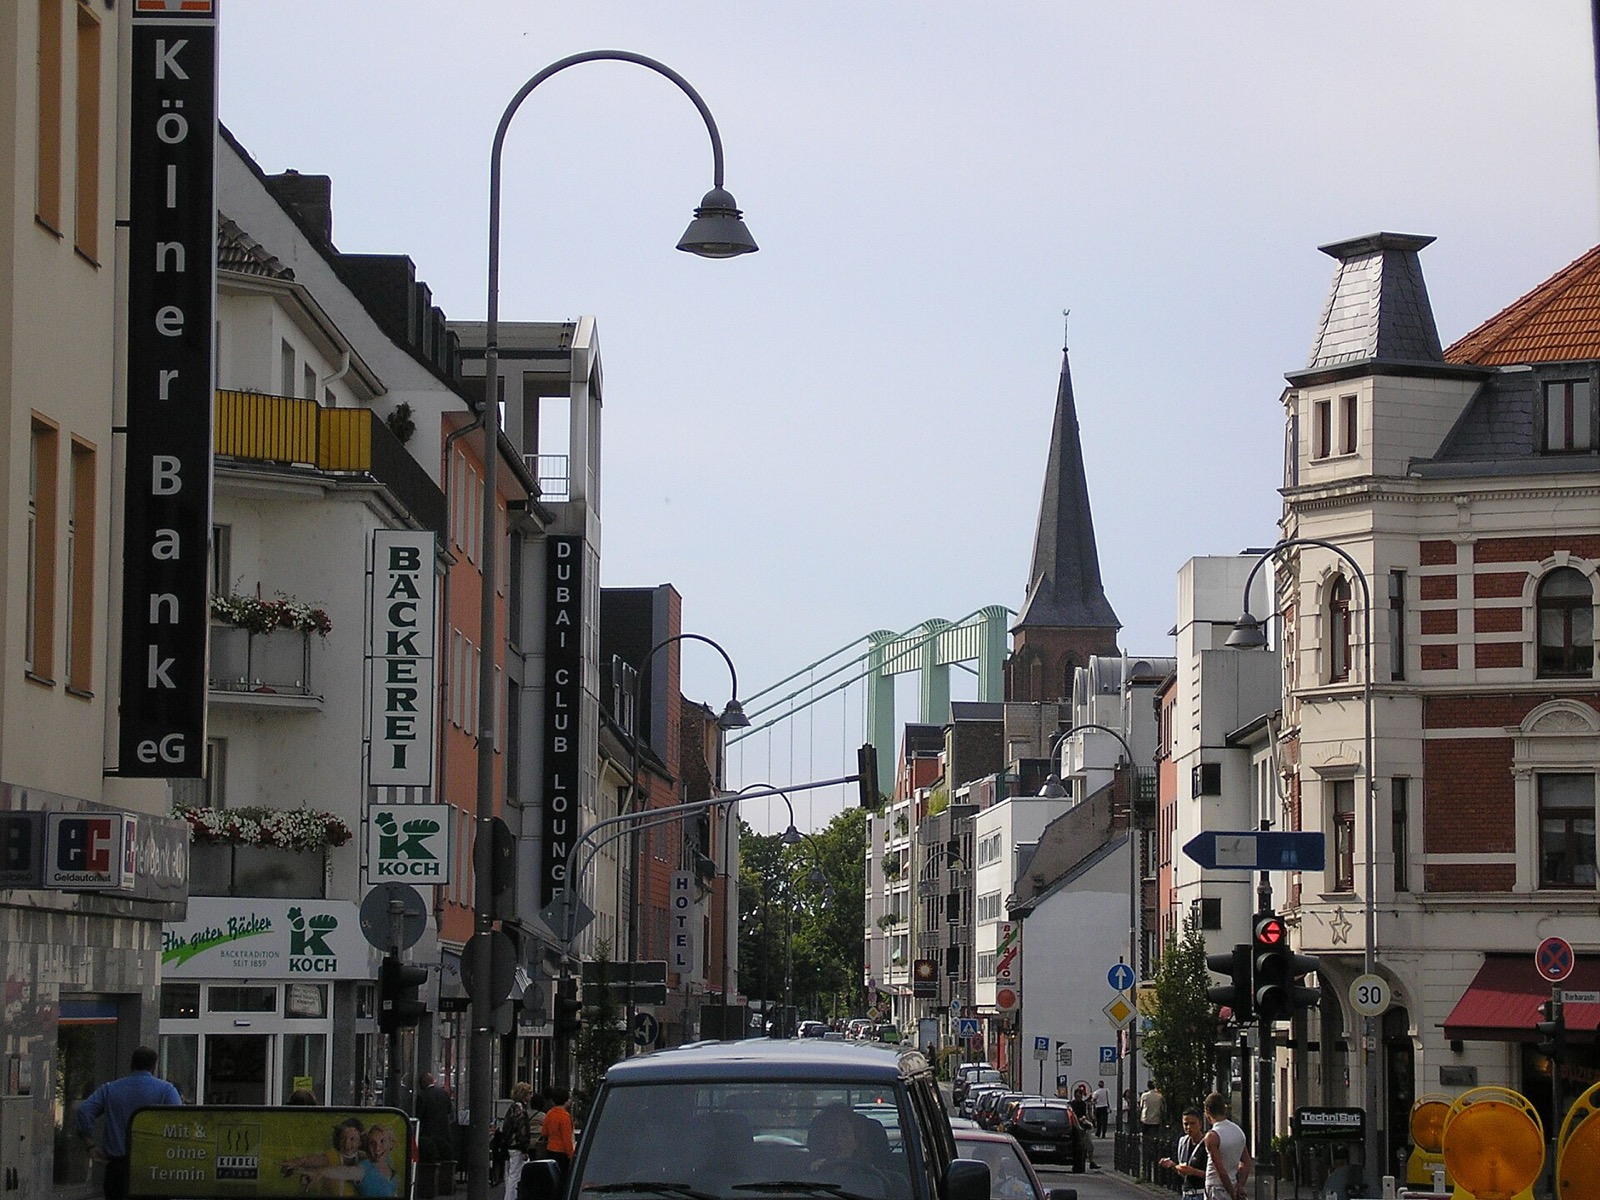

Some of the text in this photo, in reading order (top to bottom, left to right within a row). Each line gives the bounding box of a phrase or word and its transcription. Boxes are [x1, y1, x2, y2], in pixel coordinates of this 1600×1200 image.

[137, 39, 189, 763] Kölner Bank eG
[555, 542, 571, 648] DUBAI
[384, 546, 421, 769] BÄCKEREI
[554, 669, 569, 753] CLUB
[378, 862, 440, 876] KOCH
[54, 873, 111, 882] Geldautomat
[676, 878, 688, 965] HOTEL
[162, 913, 272, 952] Ihr guter Bäcker
[220, 950, 280, 958] BACKTRADITION
[289, 958, 337, 972] KOCH
[1358, 986, 1381, 1004] 30
[1301, 1112, 1360, 1122] TechniSat
[163, 1124, 207, 1138] Mit &
[166, 1146, 206, 1159] ohne
[149, 1166, 205, 1180] Termin
